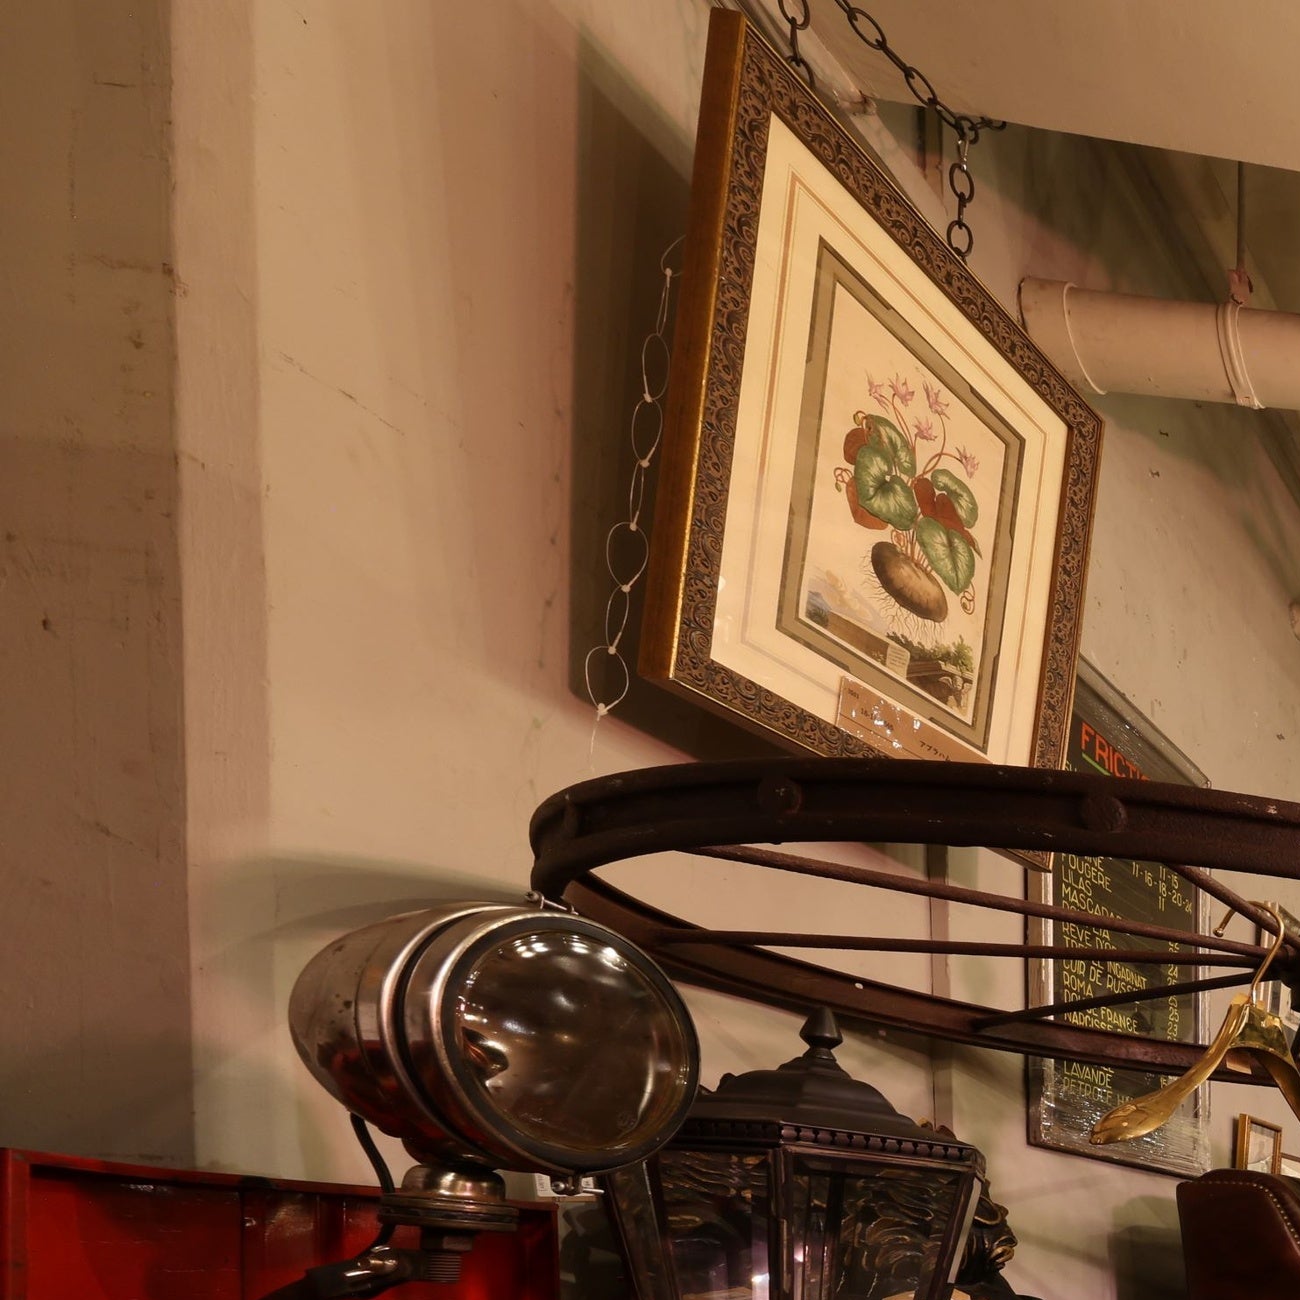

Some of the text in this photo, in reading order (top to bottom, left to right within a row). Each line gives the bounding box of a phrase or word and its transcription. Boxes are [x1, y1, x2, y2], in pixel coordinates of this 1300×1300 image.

[1062, 865, 1092, 896] LILAS
[1063, 971, 1094, 998] ROMA
[1089, 966, 1102, 986] DE
[1101, 1006, 1139, 1035] FRANCE
[1063, 1060, 1113, 1089] LAVANDE
